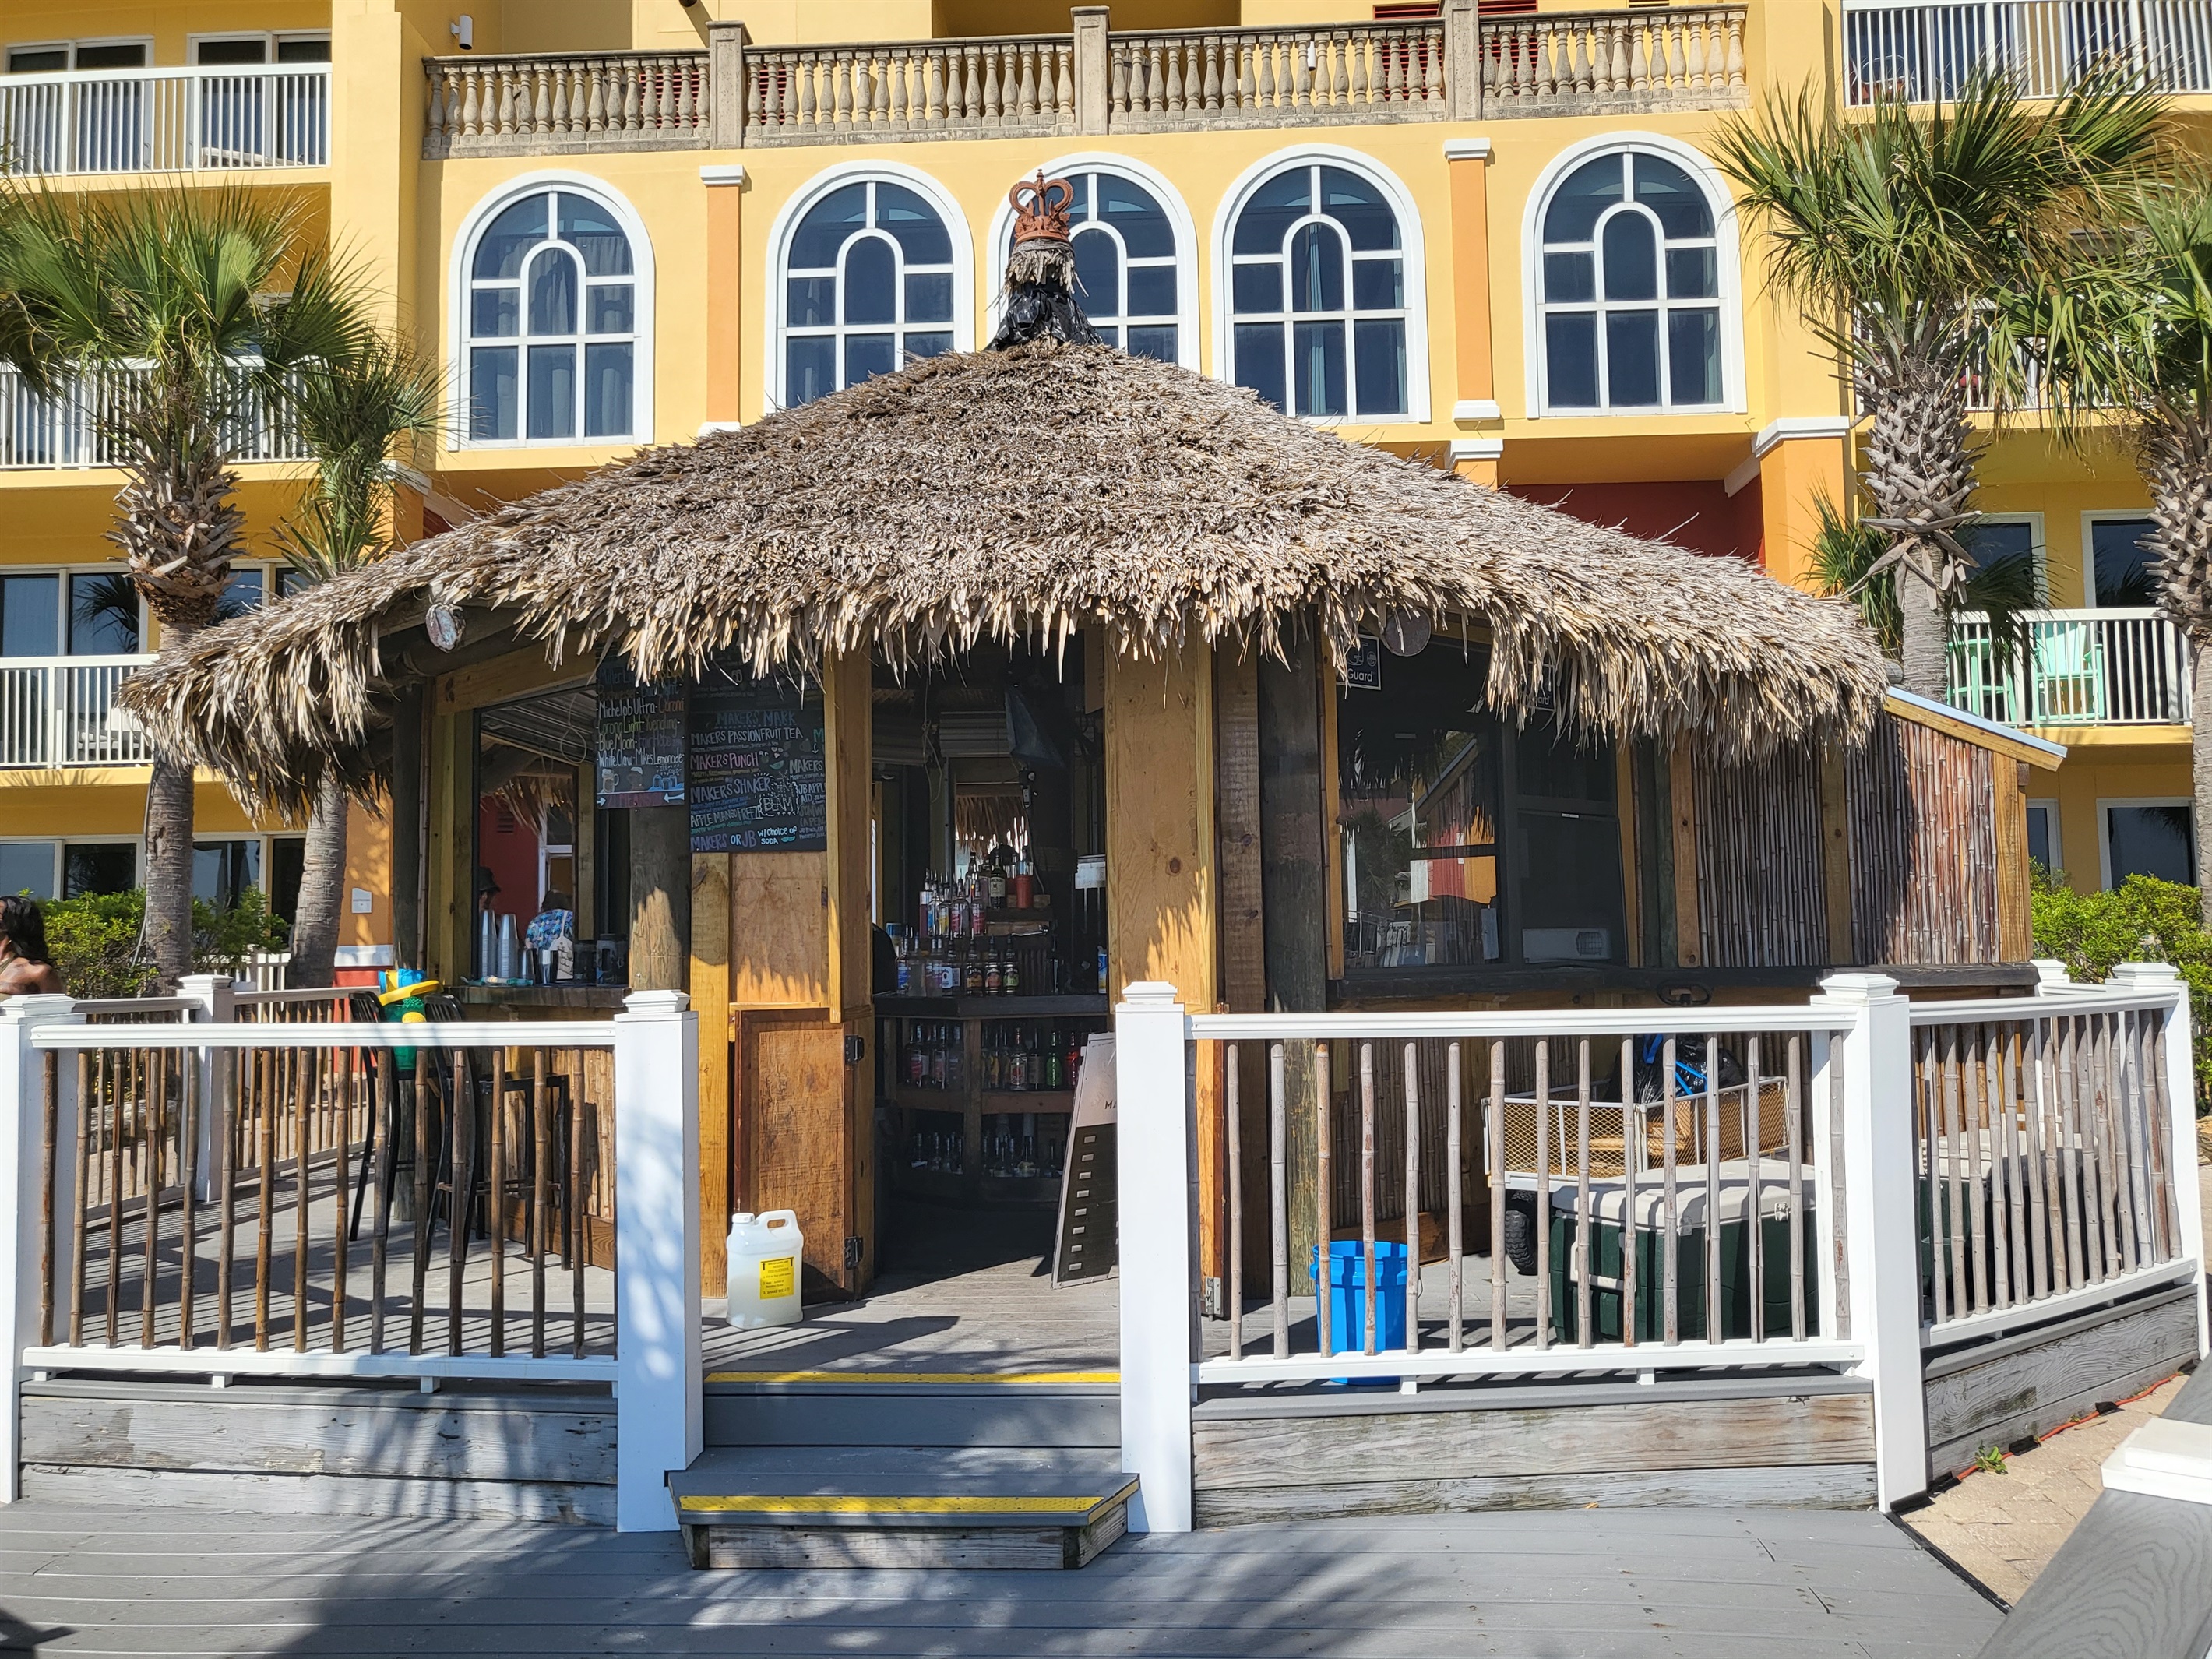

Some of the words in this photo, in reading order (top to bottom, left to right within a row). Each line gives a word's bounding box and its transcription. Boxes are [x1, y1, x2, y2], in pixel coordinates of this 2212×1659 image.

[599, 698, 633, 719] Michelob
[633, 697, 657, 715] Ultra
[658, 695, 685, 713] Corona
[598, 718, 624, 735] Corona
[623, 714, 643, 741] Light
[717, 711, 761, 725] MAKERS
[763, 710, 797, 726] MARK
[598, 734, 615, 752] Blue
[615, 732, 636, 751] Moon
[691, 730, 726, 746] MAKERS
[784, 727, 804, 741] TEA
[598, 748, 618, 767] White
[617, 748, 634, 766] Claw
[635, 747, 654, 766] Mikes
[653, 745, 685, 766] Lemonade
[690, 753, 729, 770] MAKERS
[728, 752, 759, 769] PUNCH
[789, 758, 824, 774] MAKERS
[690, 784, 734, 804] MAKERS
[734, 777, 771, 795] SHAKER
[808, 782, 825, 794] APPL
[763, 797, 794, 812] BEAM
[690, 813, 714, 829] APPLE
[713, 808, 738, 824] MANGO
[690, 833, 728, 851] MAKERS
[730, 833, 741, 847] OR
[741, 830, 756, 848] JB
[761, 837, 779, 847] SODA
